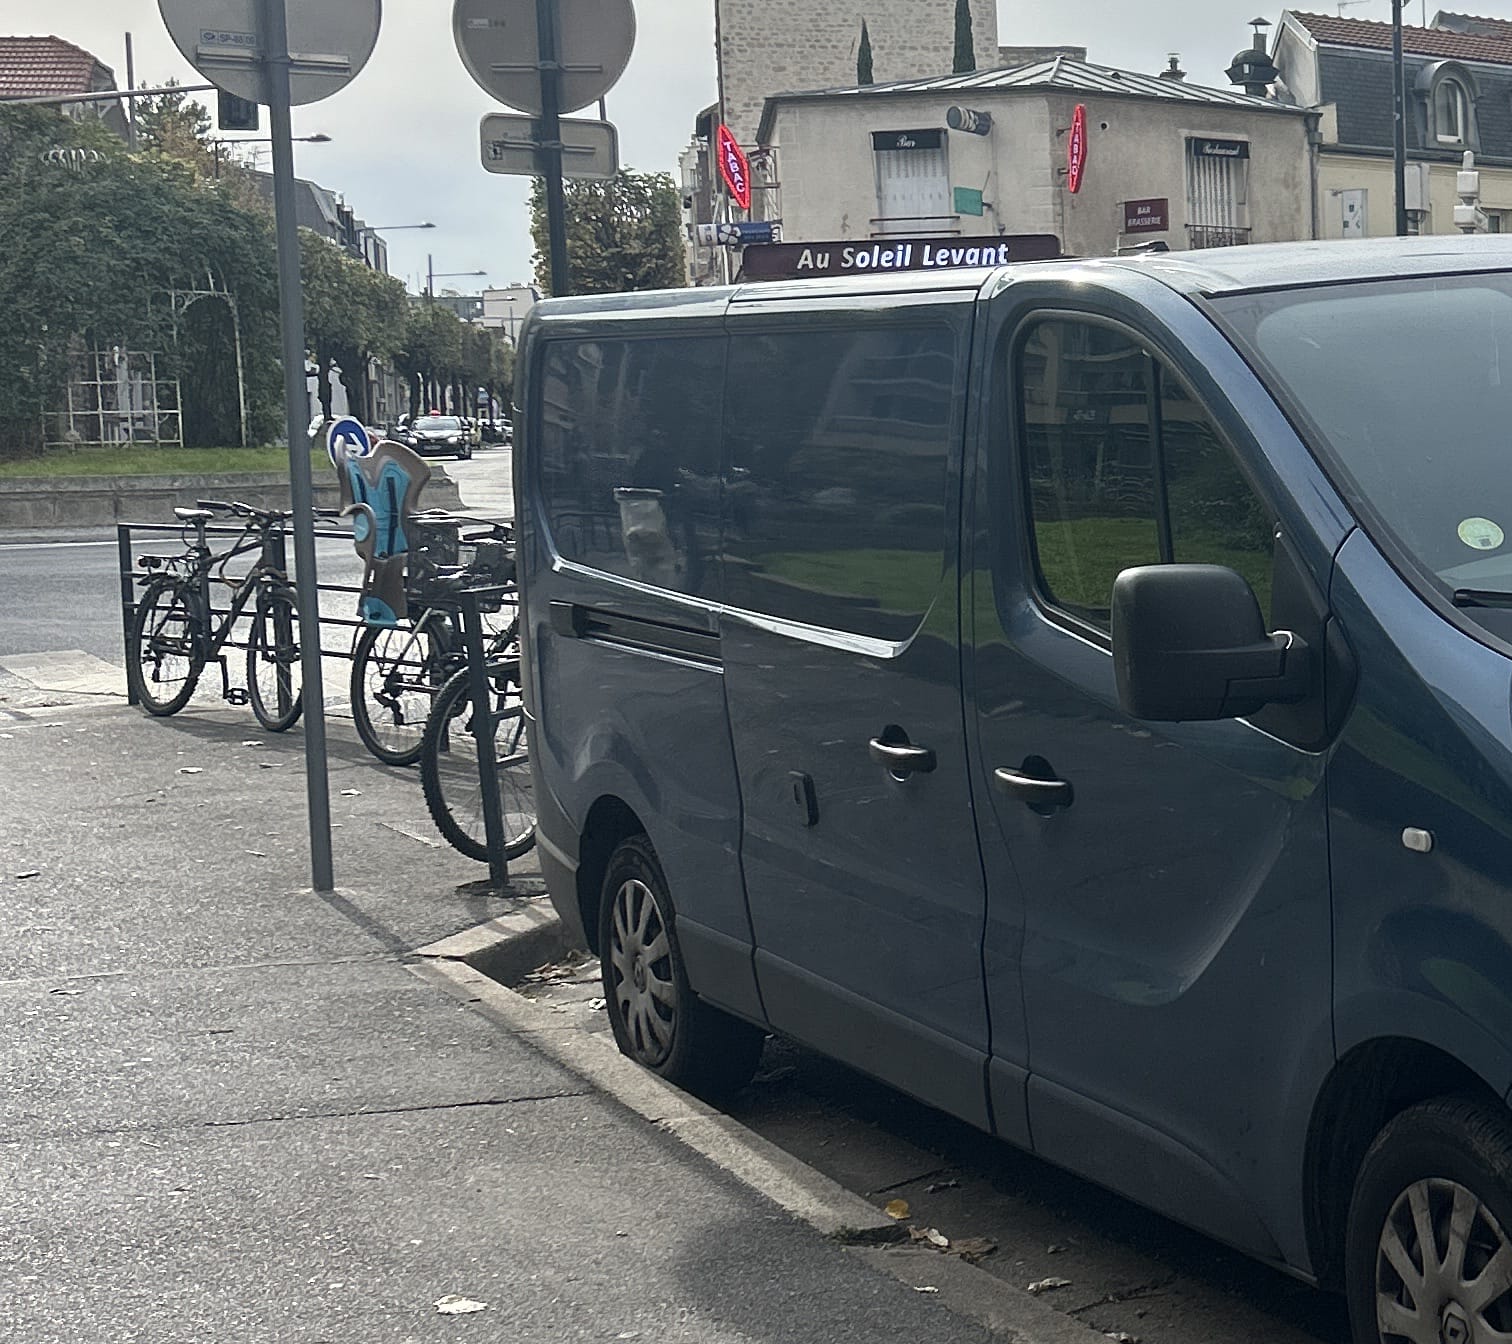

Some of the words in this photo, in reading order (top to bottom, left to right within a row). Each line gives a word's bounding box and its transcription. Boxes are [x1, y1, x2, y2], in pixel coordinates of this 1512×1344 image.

[1071, 122, 1081, 175] TABAC
[723, 141, 745, 193] TABAC
[1127, 216, 1161, 227] BRASSERIE
[1137, 206, 1151, 215] BAR
[797, 248, 830, 269] Au
[841, 243, 912, 268] Soleil
[923, 242, 1008, 266] Levant
